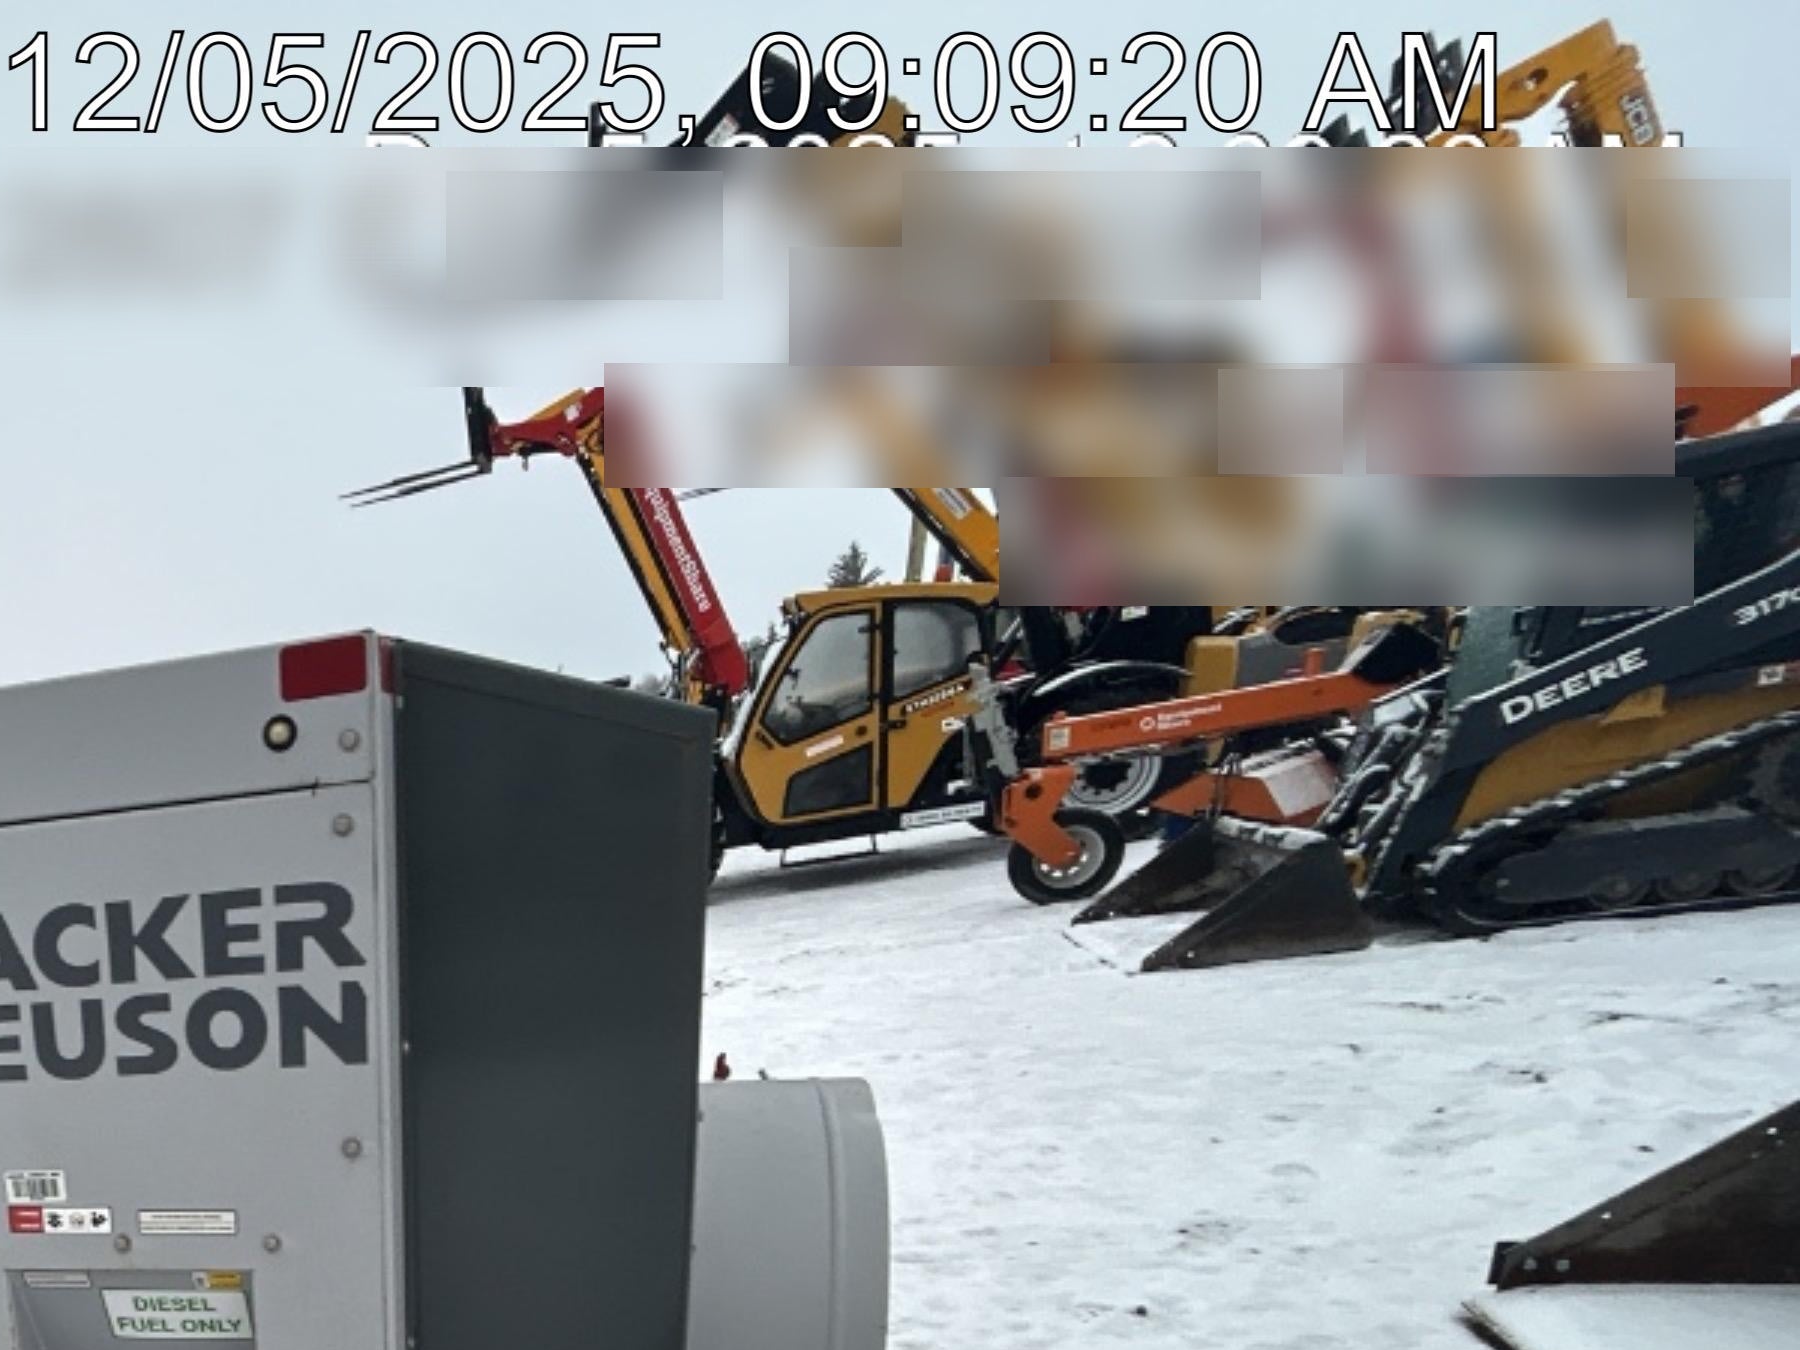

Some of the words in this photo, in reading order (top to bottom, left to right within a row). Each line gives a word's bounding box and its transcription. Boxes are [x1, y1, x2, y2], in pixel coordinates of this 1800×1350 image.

[644, 487, 712, 613] quipmentShare
[1499, 646, 1648, 725] DEERE
[116, 1316, 176, 1334] FUEL
[181, 1317, 243, 1334] ONLY
[131, 1295, 217, 1312] DIESEL
